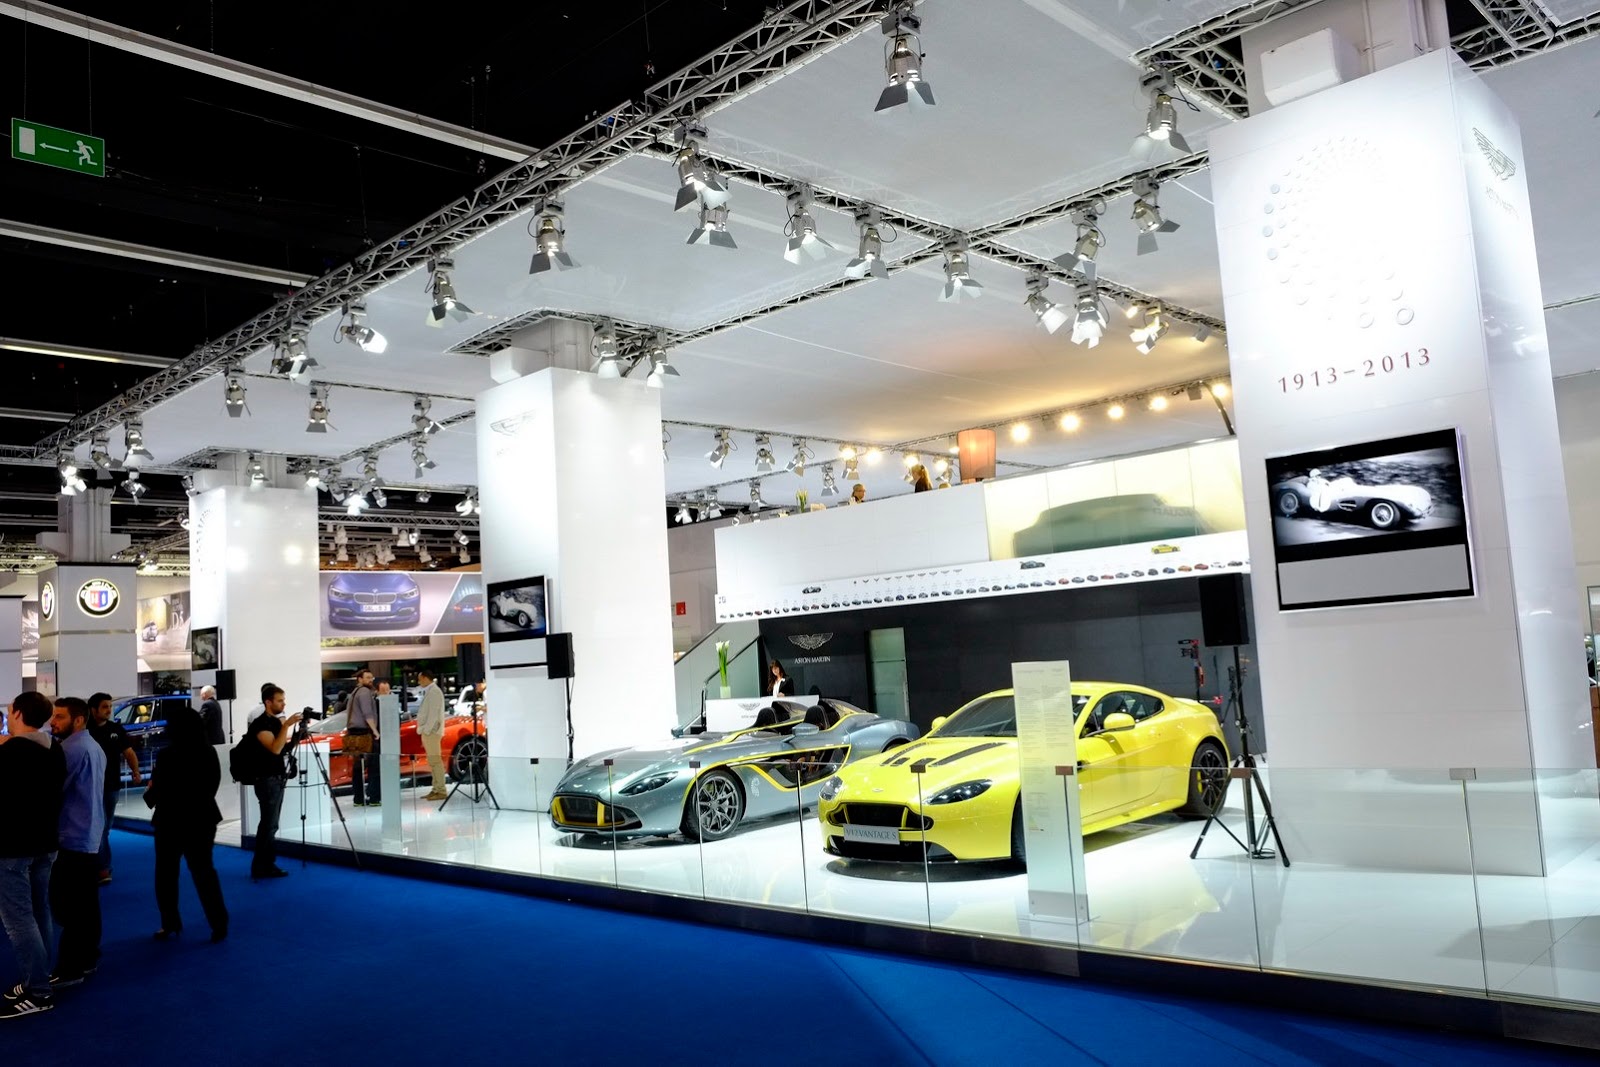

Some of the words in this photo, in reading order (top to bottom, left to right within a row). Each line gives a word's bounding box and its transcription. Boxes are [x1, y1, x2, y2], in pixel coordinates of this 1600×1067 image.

[794, 656, 811, 664] ASTON
[811, 655, 831, 663] MARTIN
[859, 829, 891, 840] VANTAGE
[892, 831, 897, 840] S
